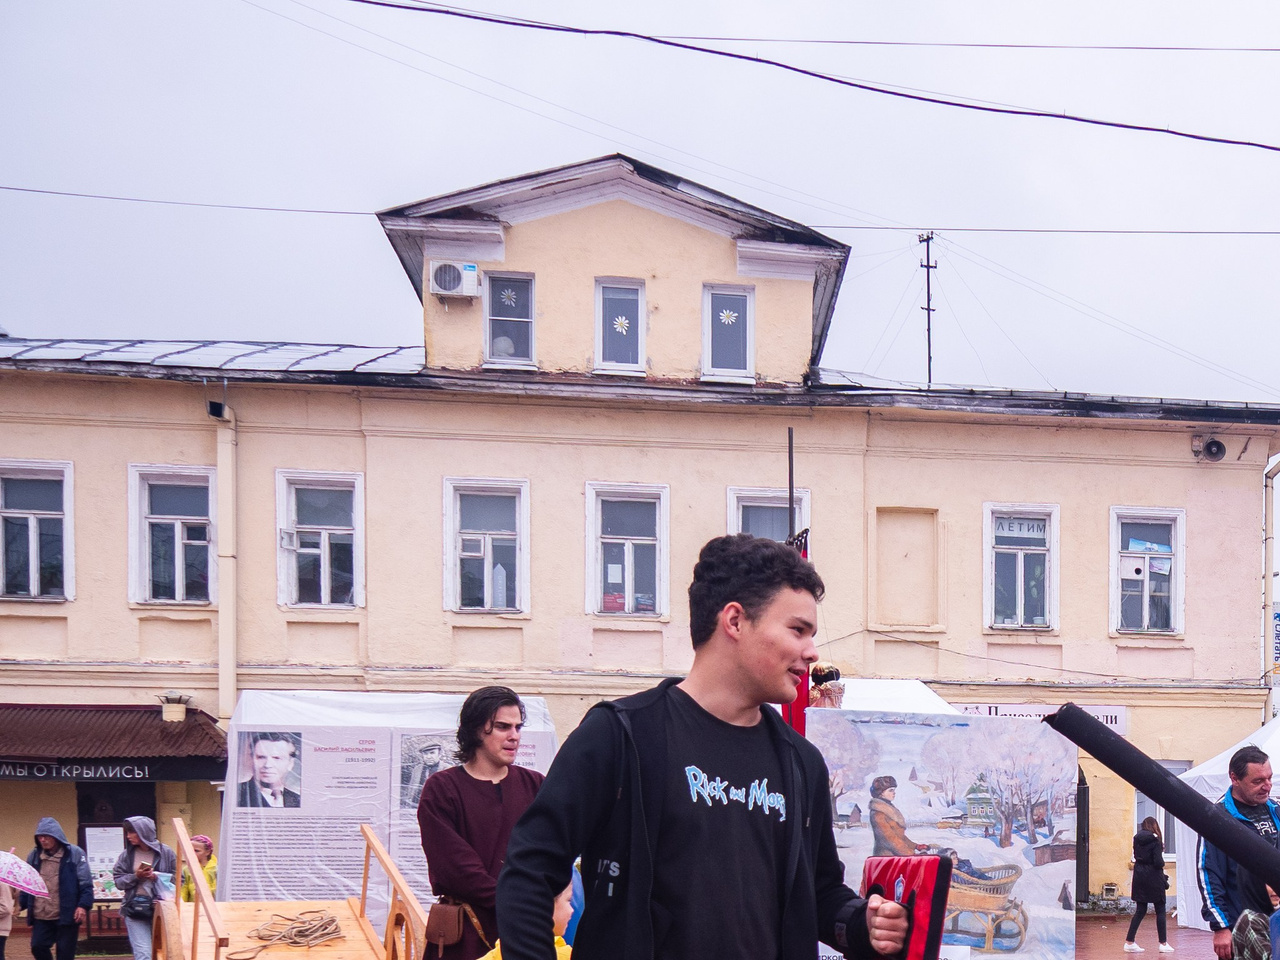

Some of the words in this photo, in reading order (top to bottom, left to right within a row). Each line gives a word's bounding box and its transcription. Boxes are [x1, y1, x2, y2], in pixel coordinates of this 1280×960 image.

[996, 521, 1046, 533] ЛЕТИМ
[0, 764, 28, 776] МЫ
[34, 764, 149, 778] ОТКРЫЛИСЬ!
[685, 765, 728, 807] Rick
